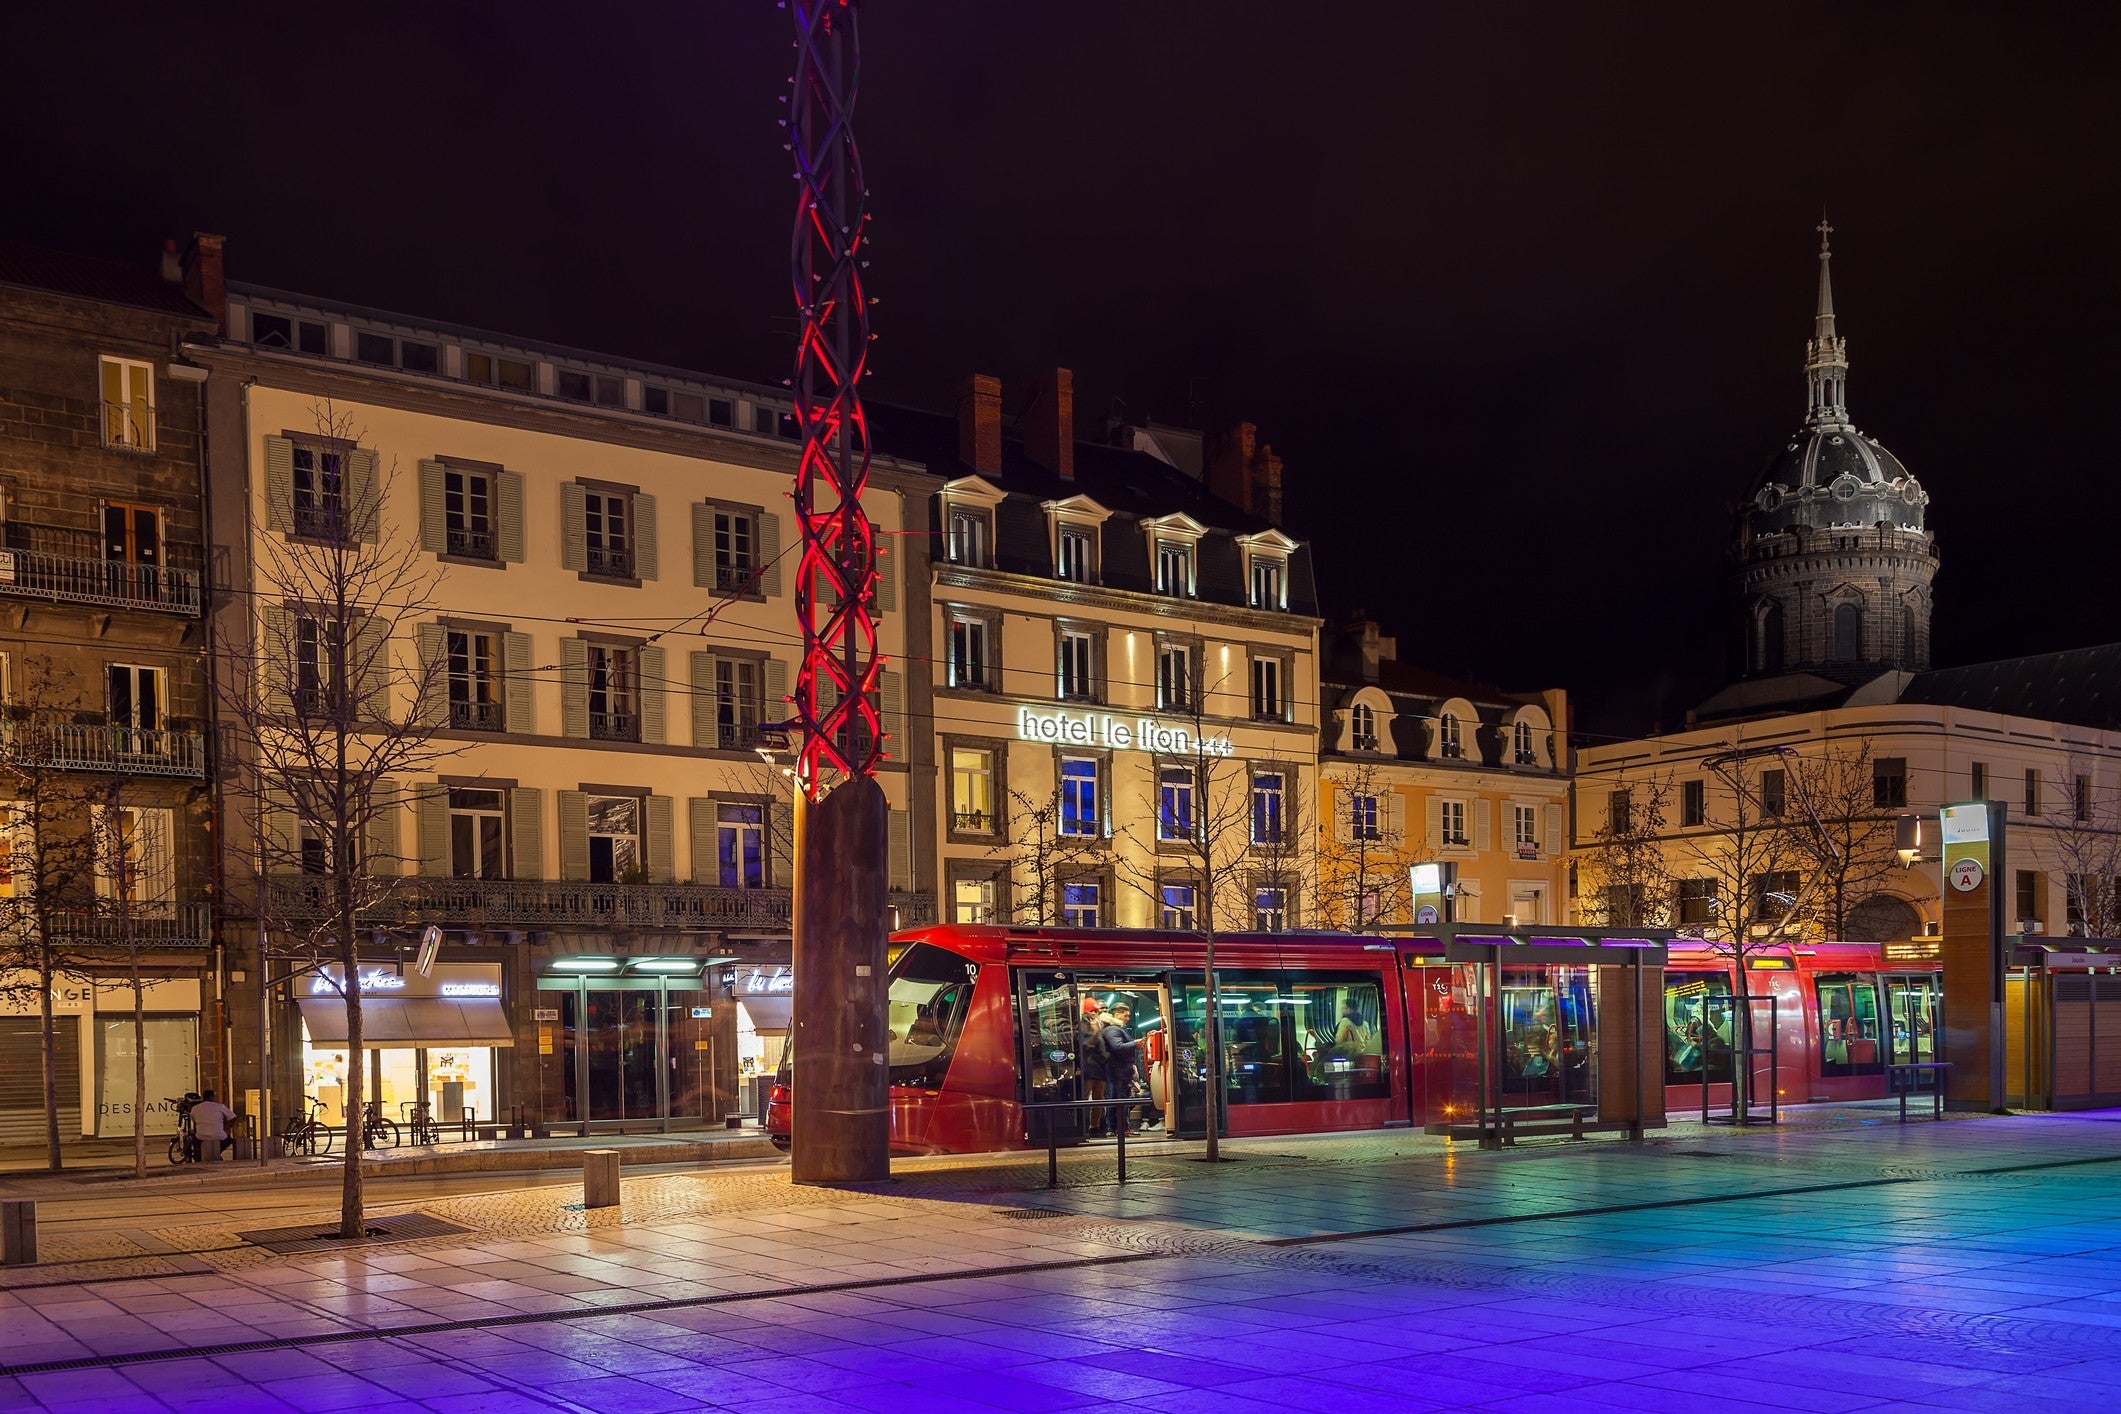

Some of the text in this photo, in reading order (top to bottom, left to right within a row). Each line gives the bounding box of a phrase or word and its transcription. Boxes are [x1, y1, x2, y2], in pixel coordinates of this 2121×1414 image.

[1022, 709, 1094, 742] hotel
[1107, 717, 1131, 745] le
[1142, 721, 1188, 751] lion
[1955, 865, 1977, 873] LIGNE
[1960, 874, 1972, 886] A
[965, 963, 977, 975] 10
